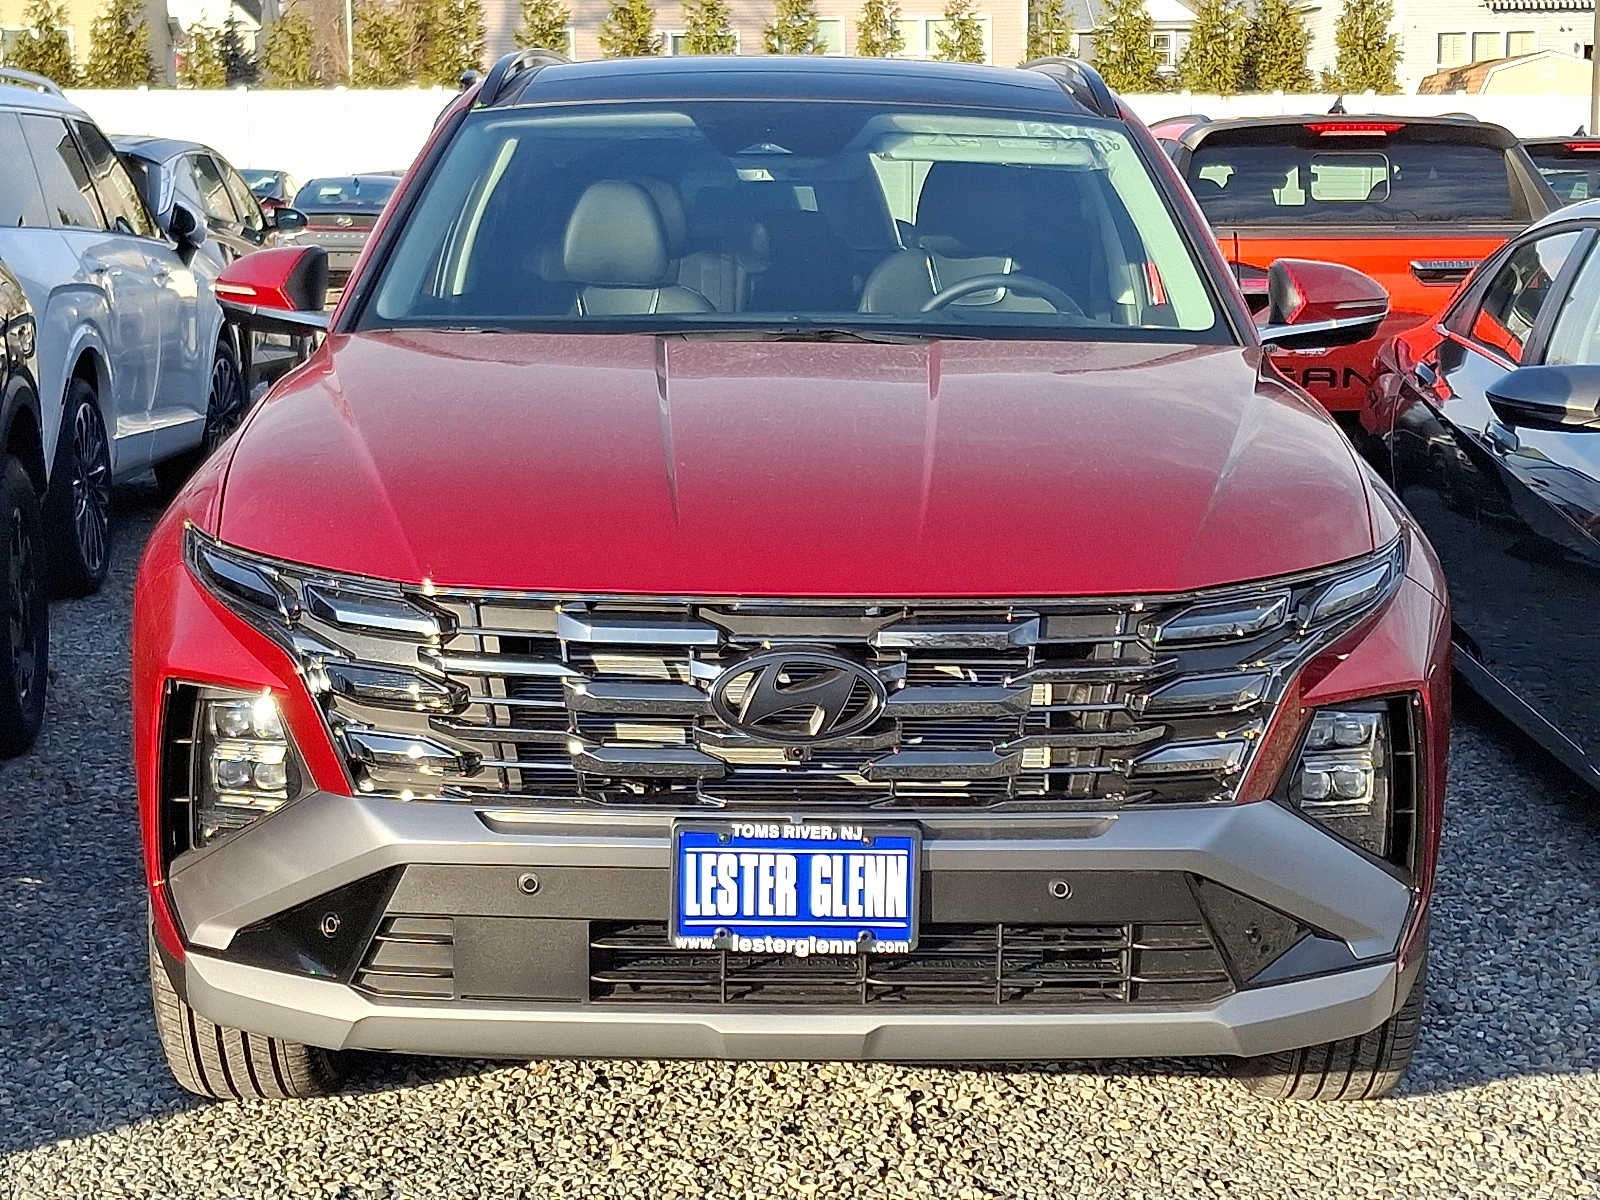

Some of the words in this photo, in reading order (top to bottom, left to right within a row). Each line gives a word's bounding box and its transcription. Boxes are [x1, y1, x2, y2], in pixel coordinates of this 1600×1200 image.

[732, 823, 779, 838] TOMS
[783, 824, 837, 841] RIVER,
[841, 826, 863, 841] NJ
[685, 853, 798, 917] LESTER
[811, 854, 908, 918] GLENN
[732, 935, 857, 957] lesterglenn
